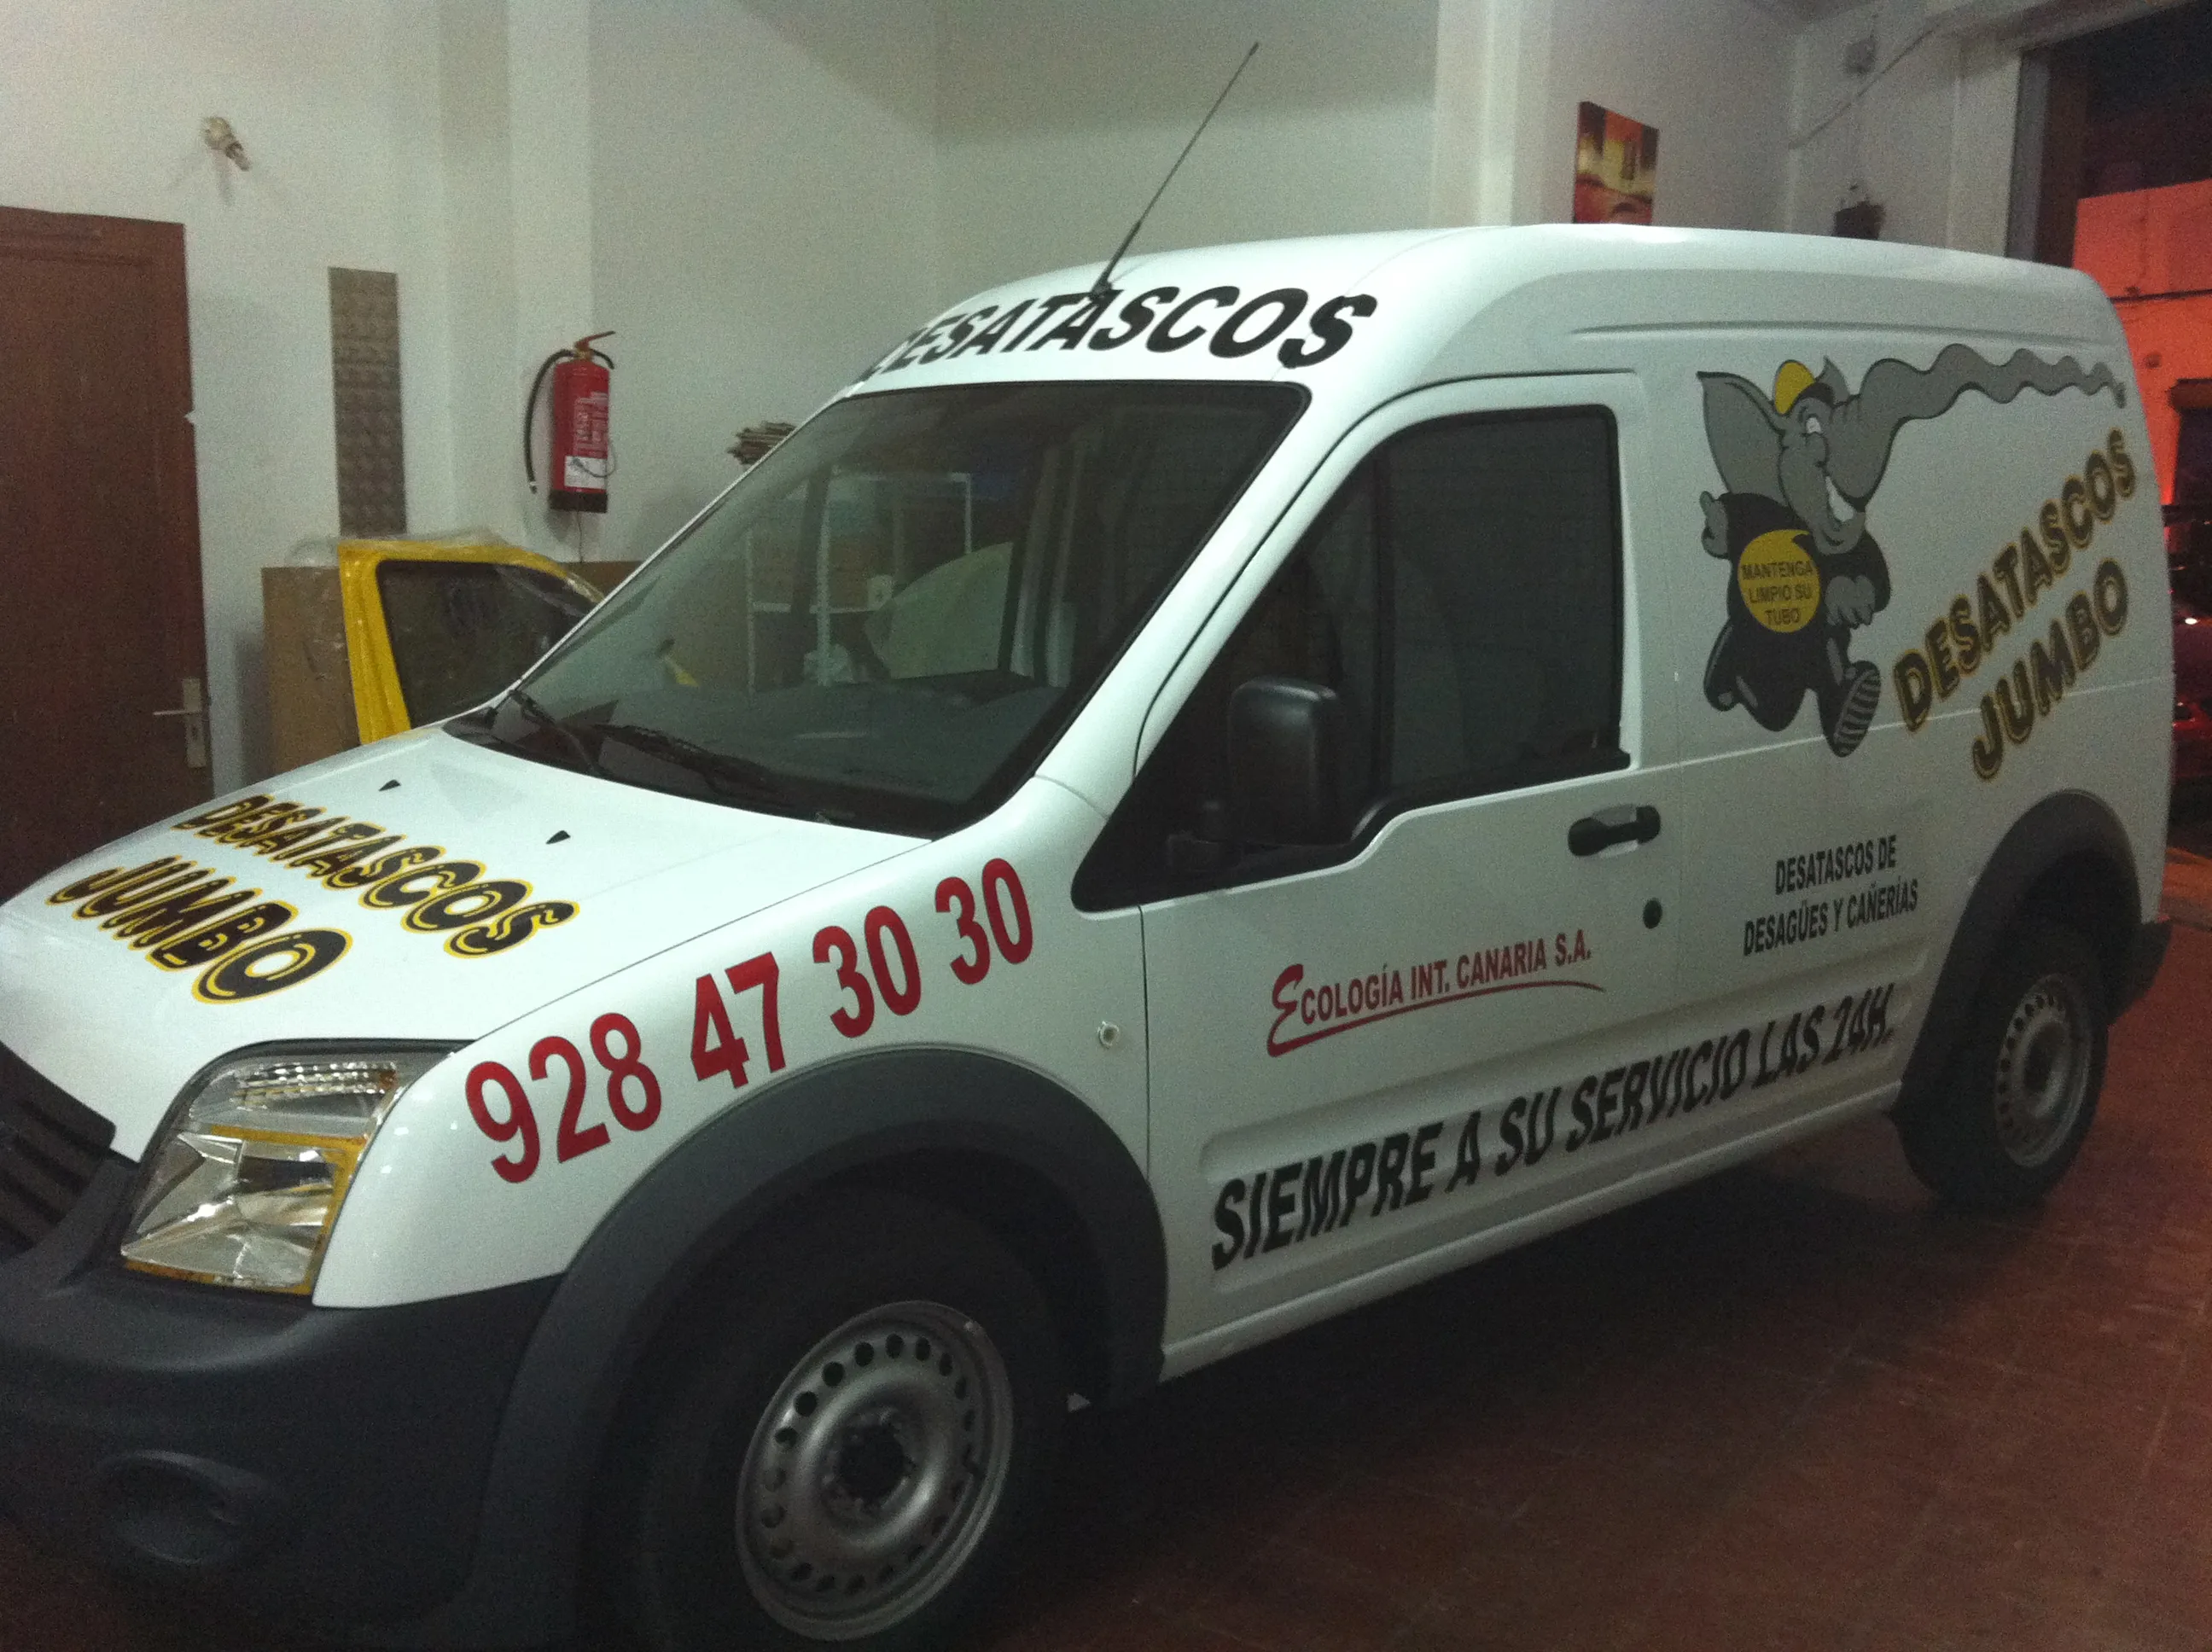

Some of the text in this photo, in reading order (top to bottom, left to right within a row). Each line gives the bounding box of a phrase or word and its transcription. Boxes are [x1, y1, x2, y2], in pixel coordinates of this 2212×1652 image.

[1765, 608, 1800, 625] TUBO
[1893, 428, 2134, 732] DESATASCOS
[1971, 558, 2129, 780] JUMBO
[44, 854, 353, 1004] JUMBO
[170, 794, 580, 959] DESATASCOS
[1743, 875, 1918, 956] DESAGÜES Y CAÑERÍAS
[1775, 835, 1896, 895] DESATASCOS DE
[464, 858, 1033, 1184] 928 47 30 30
[1411, 960, 1450, 1000] INT.
[1456, 938, 1547, 990] CANARIA
[1555, 928, 1592, 967] S.A.
[1212, 1121, 1444, 1271] SIEMPRE
[1445, 1110, 1481, 1193] A
[1494, 1085, 1562, 1177] SU
[1565, 1028, 1750, 1152] SERVICIO
[1751, 1004, 1826, 1090] LAS
